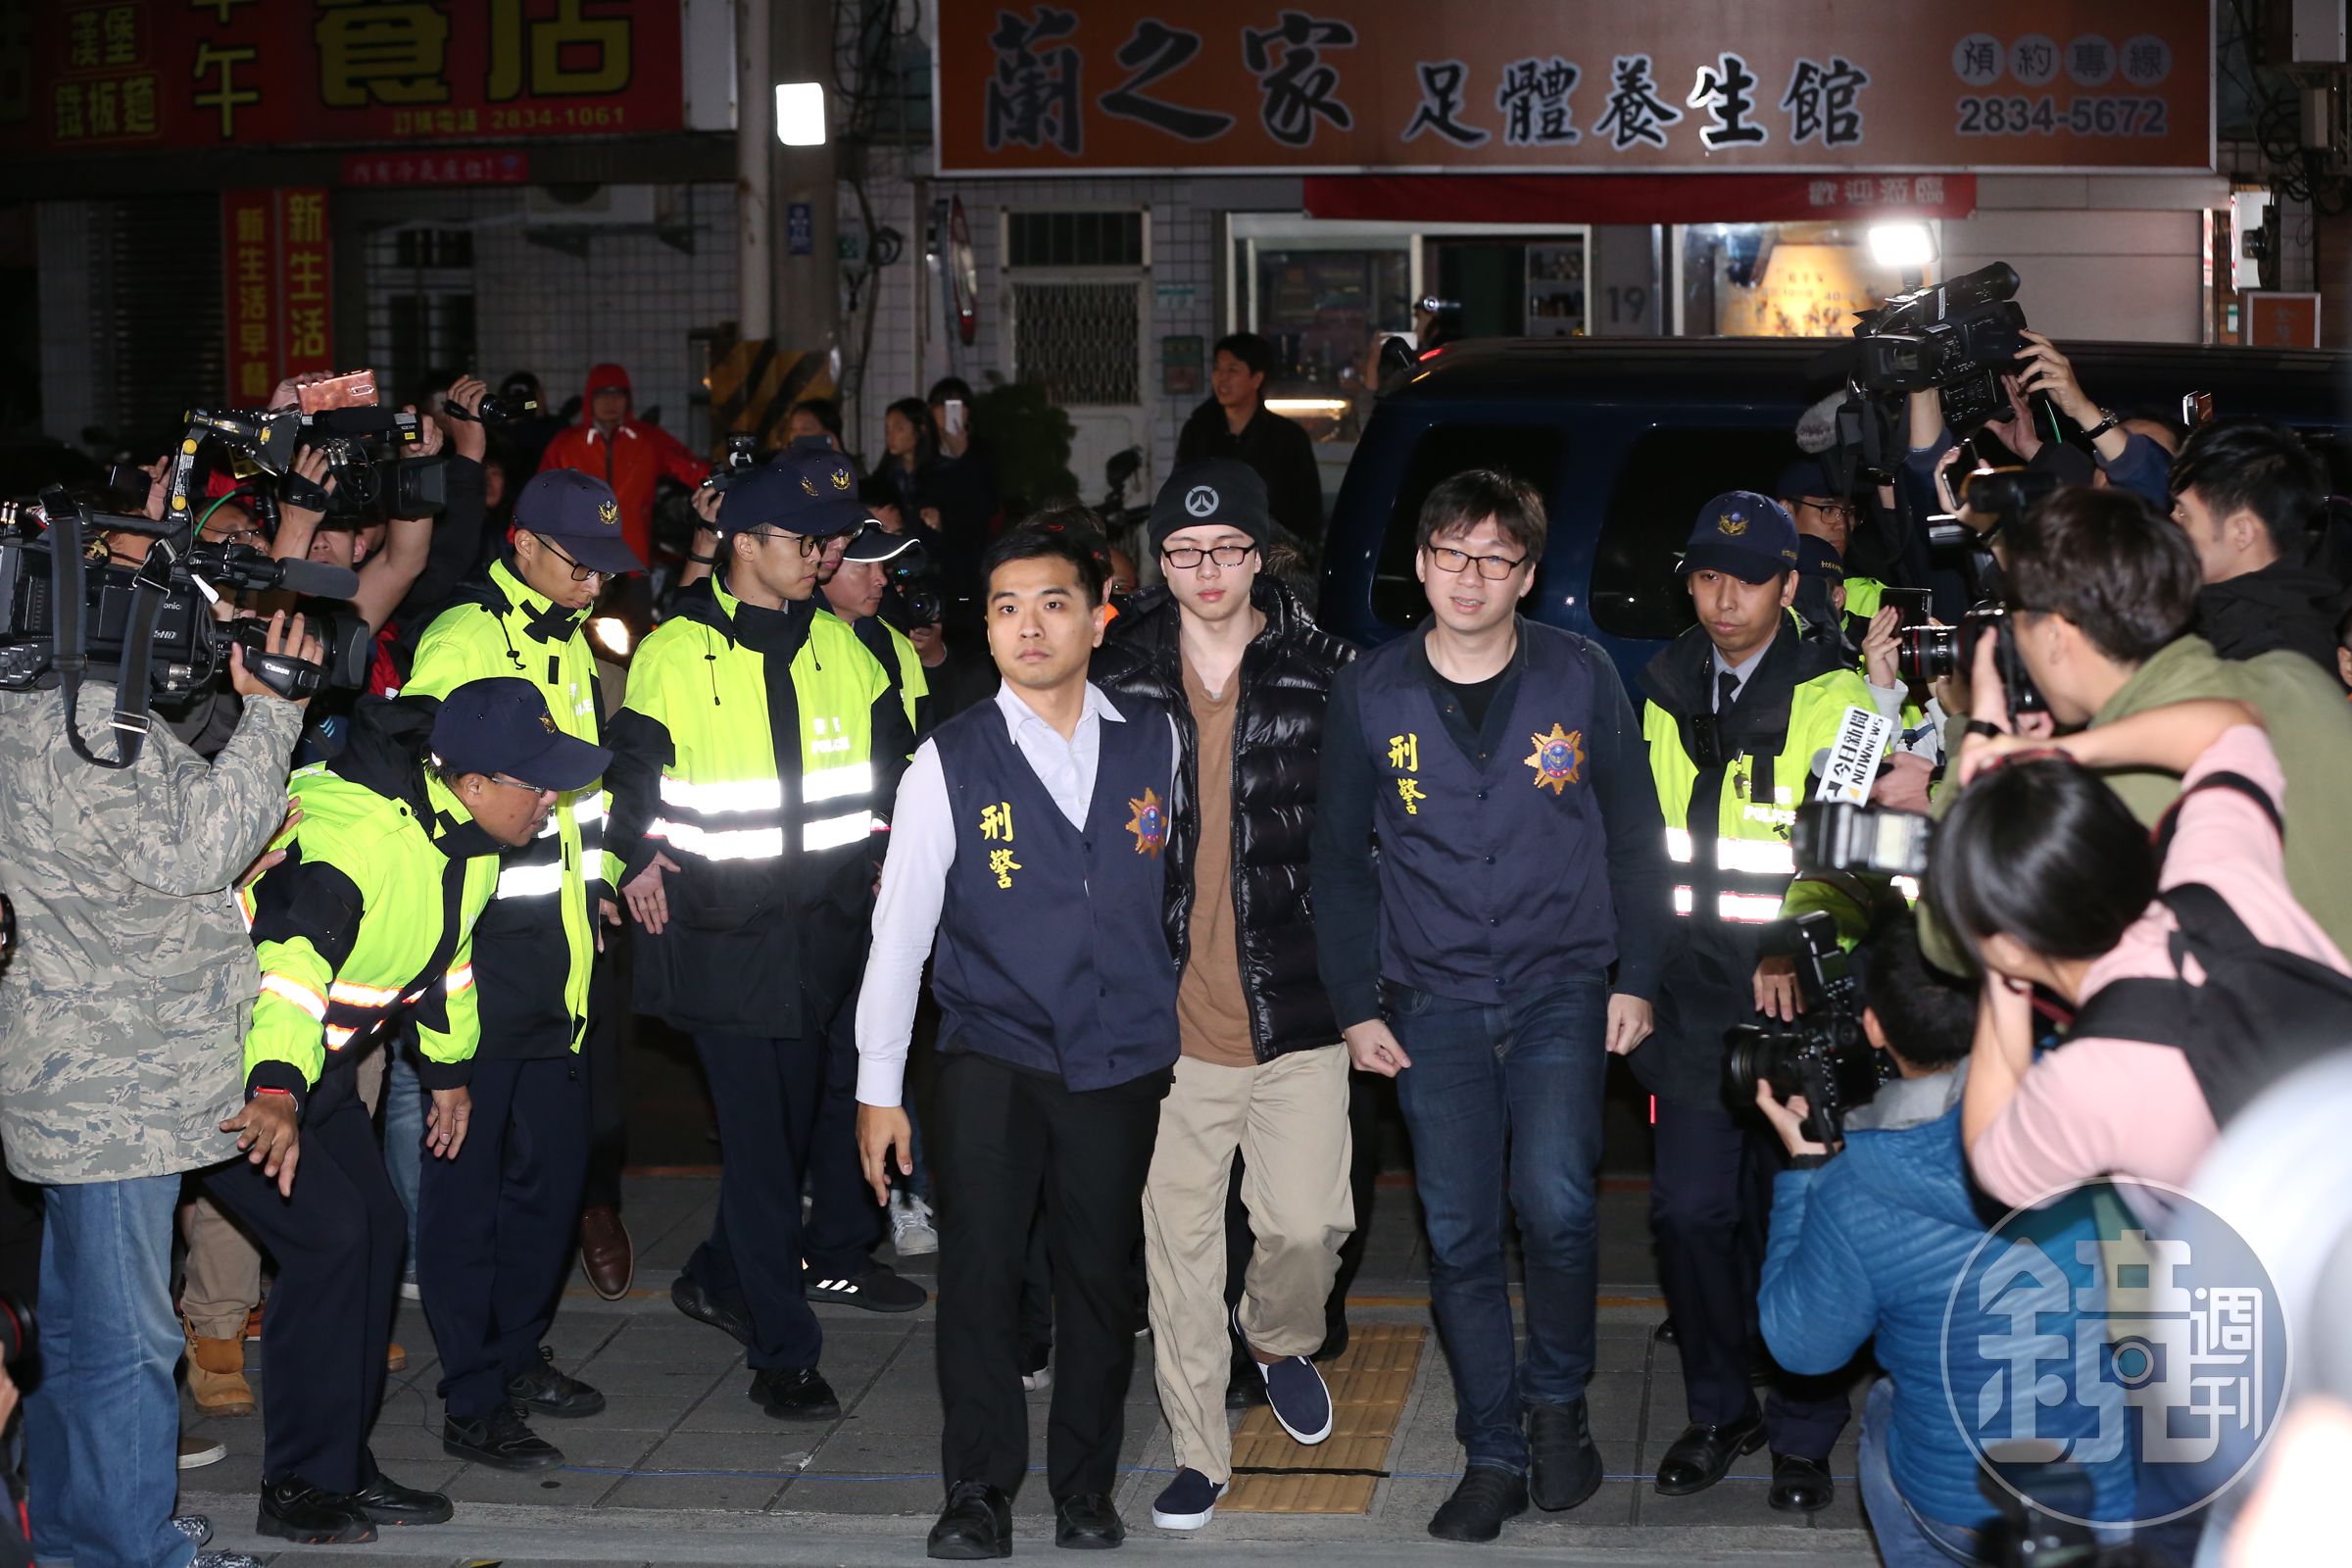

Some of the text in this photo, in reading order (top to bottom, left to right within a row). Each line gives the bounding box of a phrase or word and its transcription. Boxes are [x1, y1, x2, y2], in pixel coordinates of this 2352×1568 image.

[70, 6, 136, 66] 漢堡
[1961, 38, 2164, 78] 預約專線
[191, 0, 259, 138] 午
[984, 5, 1868, 157] 蘭之家 足體養生館
[492, 107, 625, 130] 2834-1061
[1958, 97, 2167, 135] 2834-5672
[288, 193, 325, 358] 新生活
[1606, 286, 1646, 322] 19
[265, 662, 290, 676] Canon
[1387, 732, 1427, 815] 刑警
[1833, 710, 1869, 778] 今日新聞
[979, 801, 1022, 889] 刑警
[1743, 806, 1796, 825] POLICE
